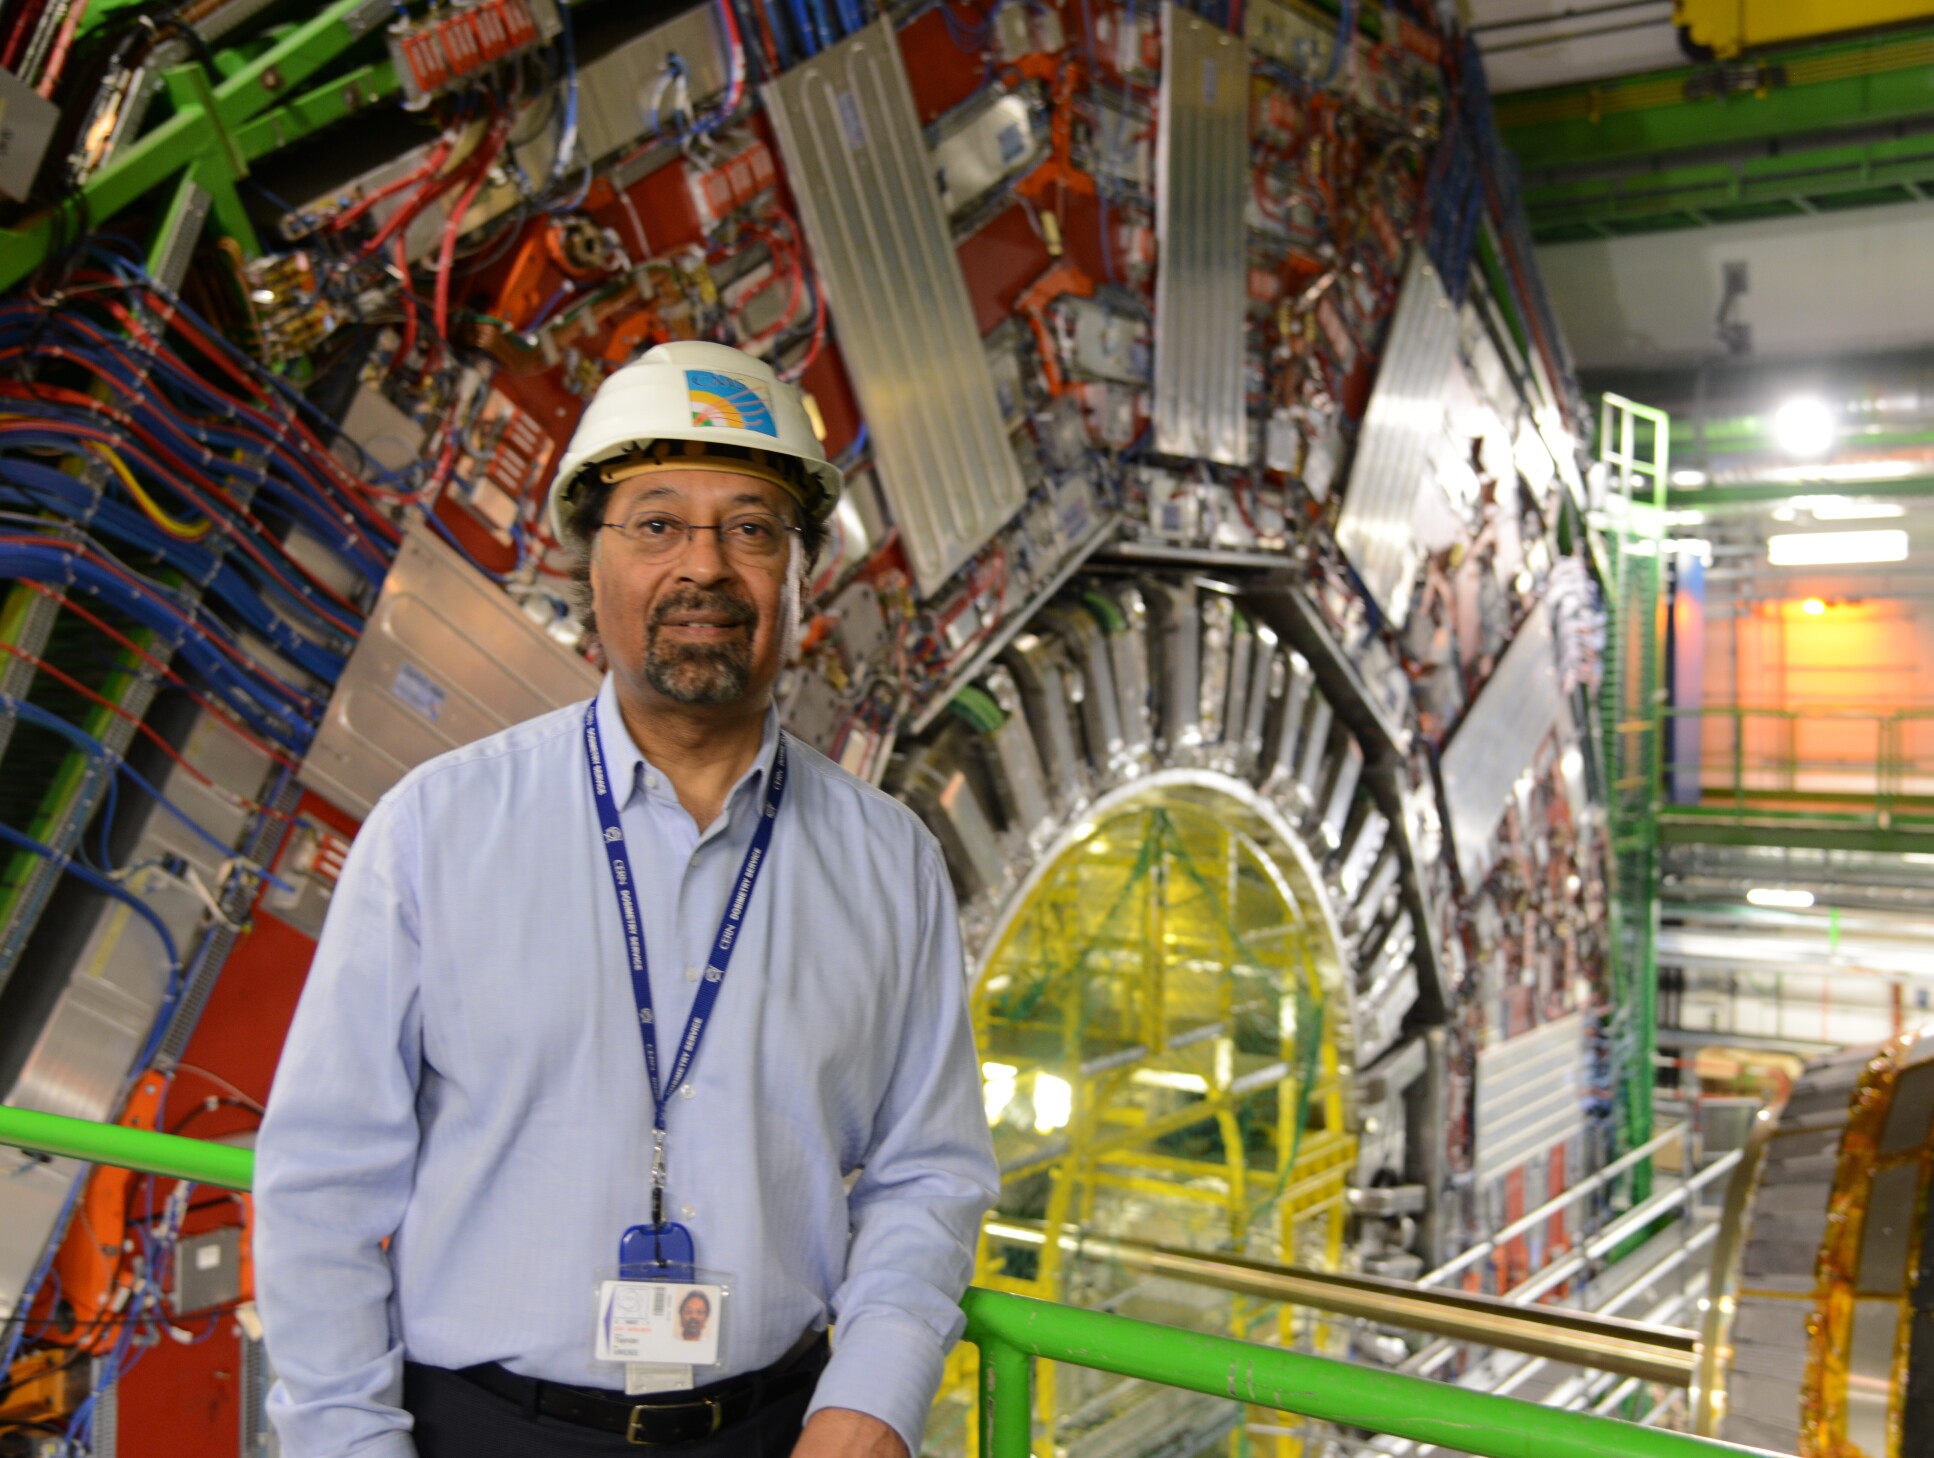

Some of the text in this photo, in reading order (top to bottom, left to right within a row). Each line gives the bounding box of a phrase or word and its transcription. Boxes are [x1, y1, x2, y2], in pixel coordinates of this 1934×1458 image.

[613, 859, 643, 971] CERN DOSIMETRY SERVICE
[719, 847, 763, 950] CERN DOSIMETRY SERVICE
[684, 1017, 704, 1052] SERVICE
